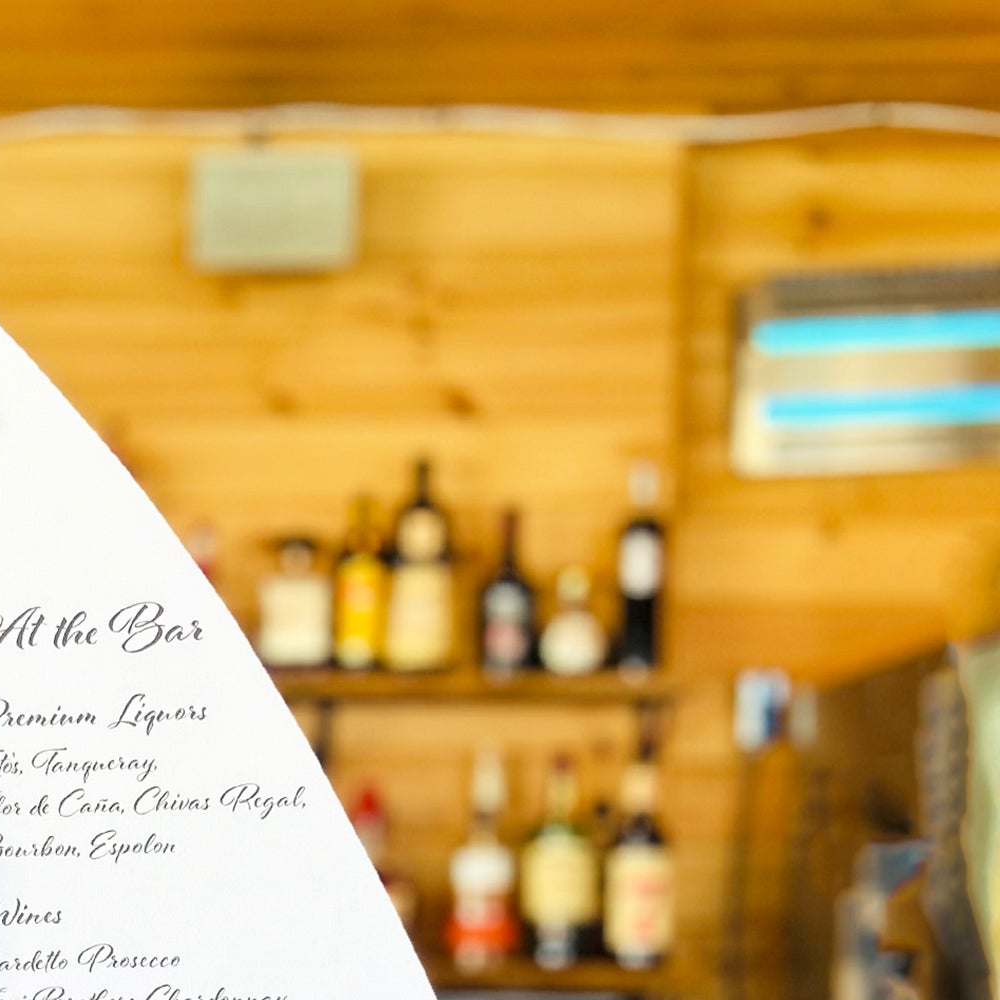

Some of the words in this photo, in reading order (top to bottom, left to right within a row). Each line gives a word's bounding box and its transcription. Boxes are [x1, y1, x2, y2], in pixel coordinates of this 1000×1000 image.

[54, 612, 96, 648] the
[109, 603, 202, 652] Bar
[109, 694, 206, 735] Liquors
[32, 748, 156, 782] Tanqueray,
[30, 796, 48, 815] de
[59, 789, 123, 816] Caña,
[134, 787, 208, 814] Chivas
[221, 784, 305, 819] Regal,
[90, 831, 174, 863] Espolon
[78, 945, 179, 972] Prosecco
